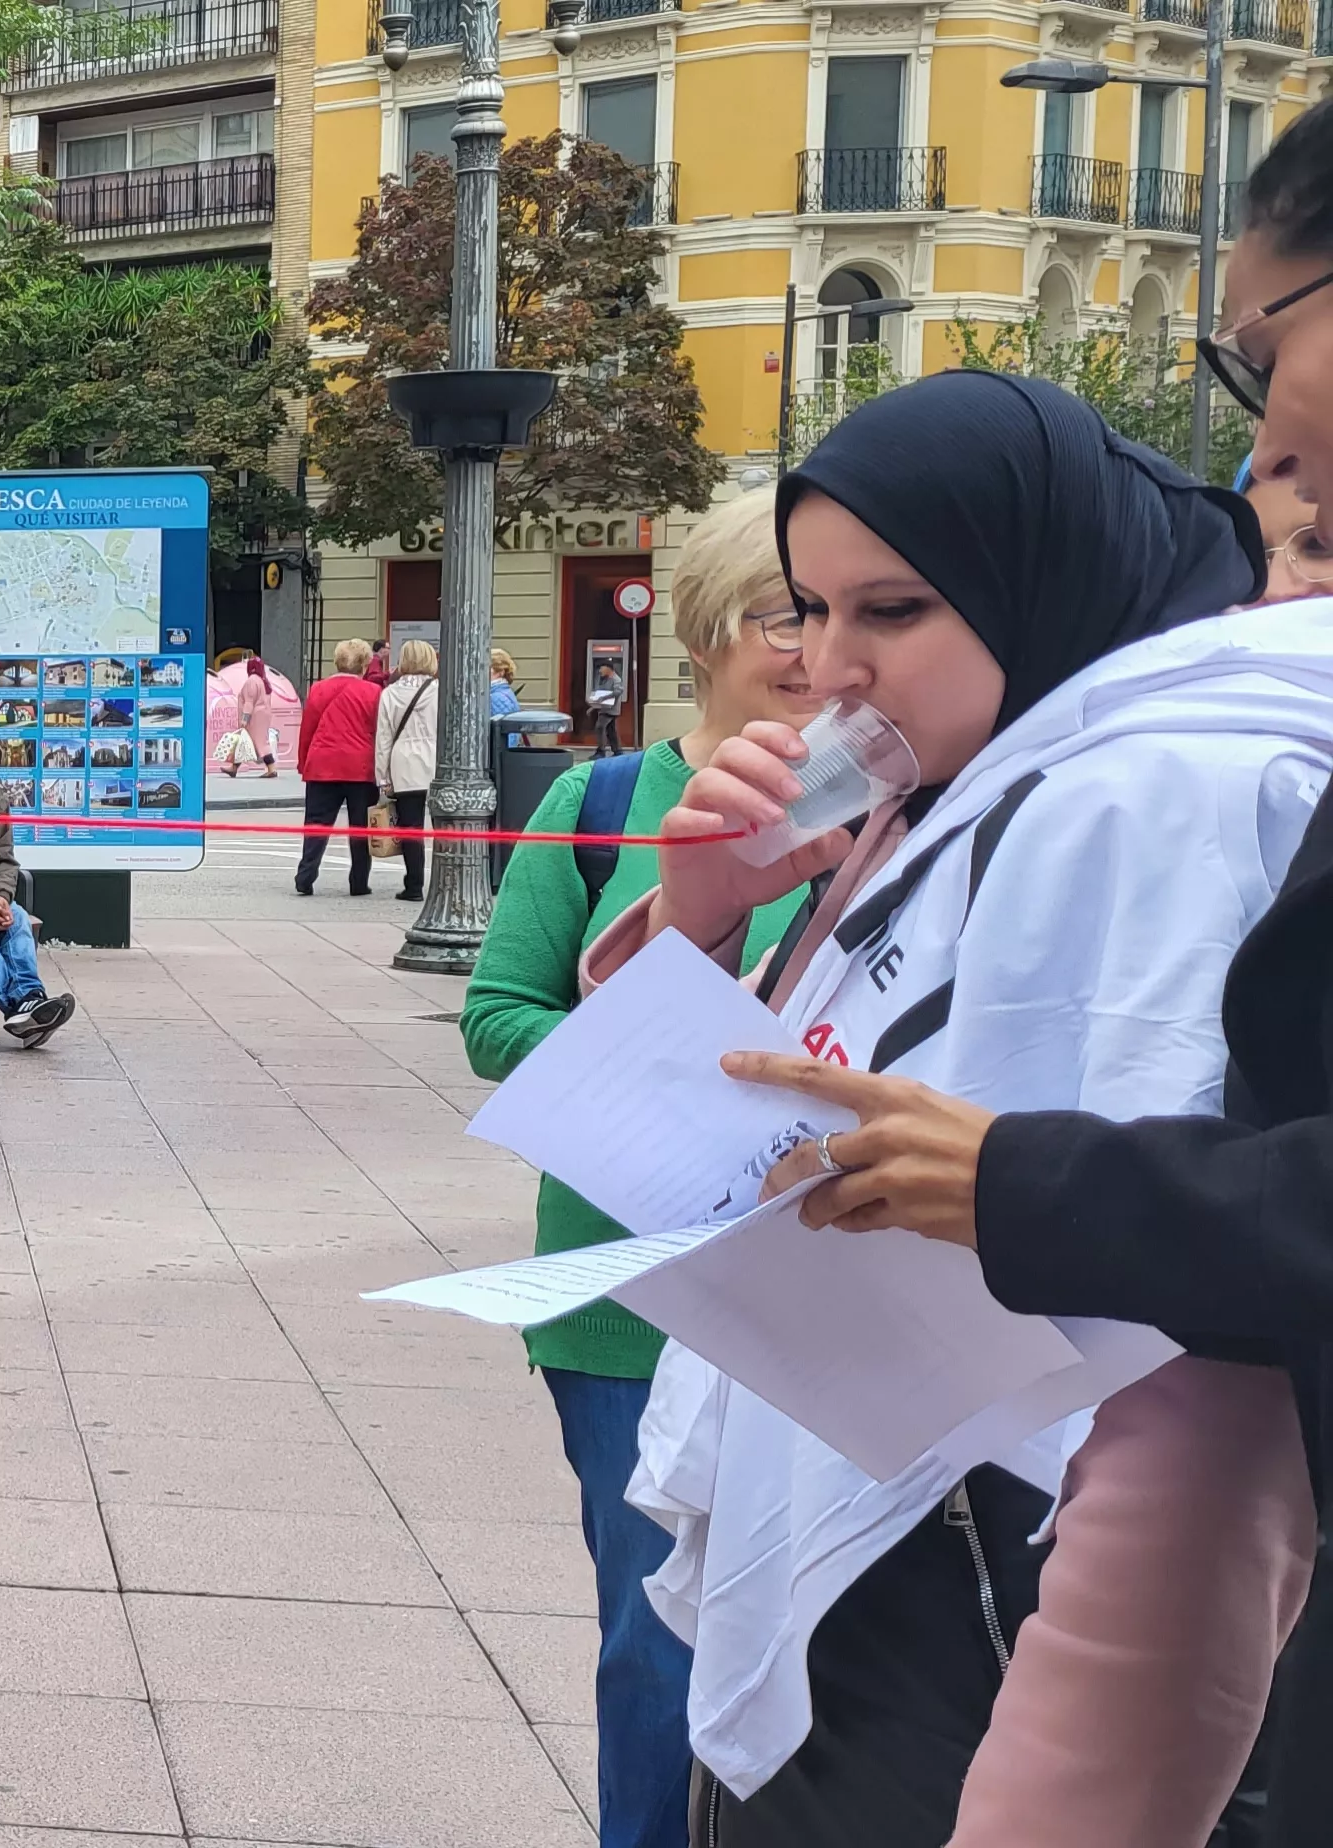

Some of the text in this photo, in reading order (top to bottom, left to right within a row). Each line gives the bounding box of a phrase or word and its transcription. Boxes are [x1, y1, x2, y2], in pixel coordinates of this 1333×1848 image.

[69, 497, 112, 509] CIUDAD
[115, 498, 131, 508] DE
[135, 497, 188, 508] LEYENDA
[14, 511, 119, 527] QUÉ VISITAR
